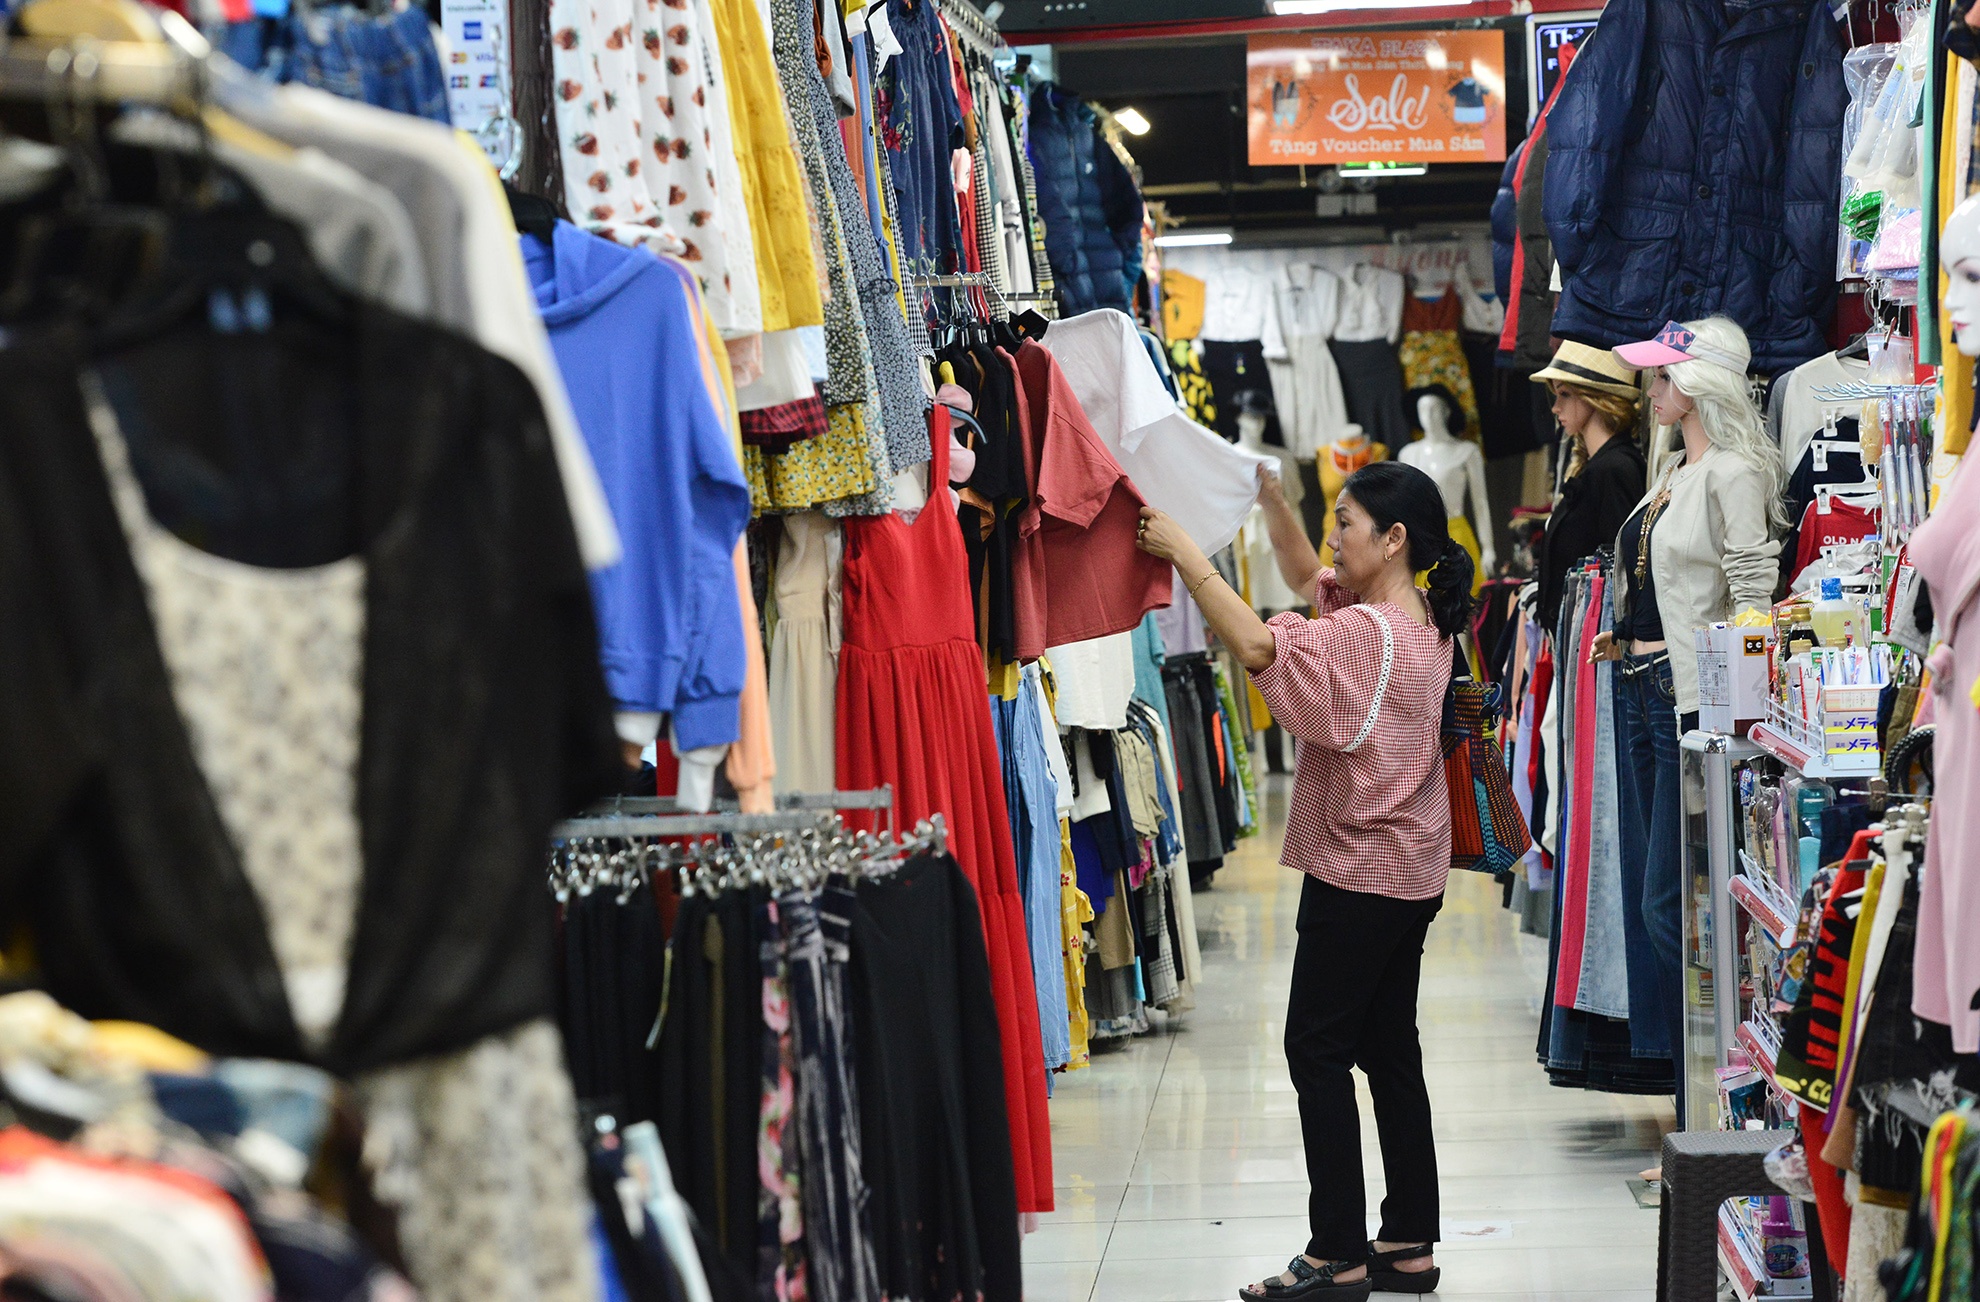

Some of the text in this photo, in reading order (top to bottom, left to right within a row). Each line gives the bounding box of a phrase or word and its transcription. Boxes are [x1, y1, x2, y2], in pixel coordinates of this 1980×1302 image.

[1326, 73, 1430, 132] Sale!
[1321, 137, 1405, 153] Voucher
[1408, 138, 1445, 152] Mua
[1823, 535, 1847, 545] OLD
